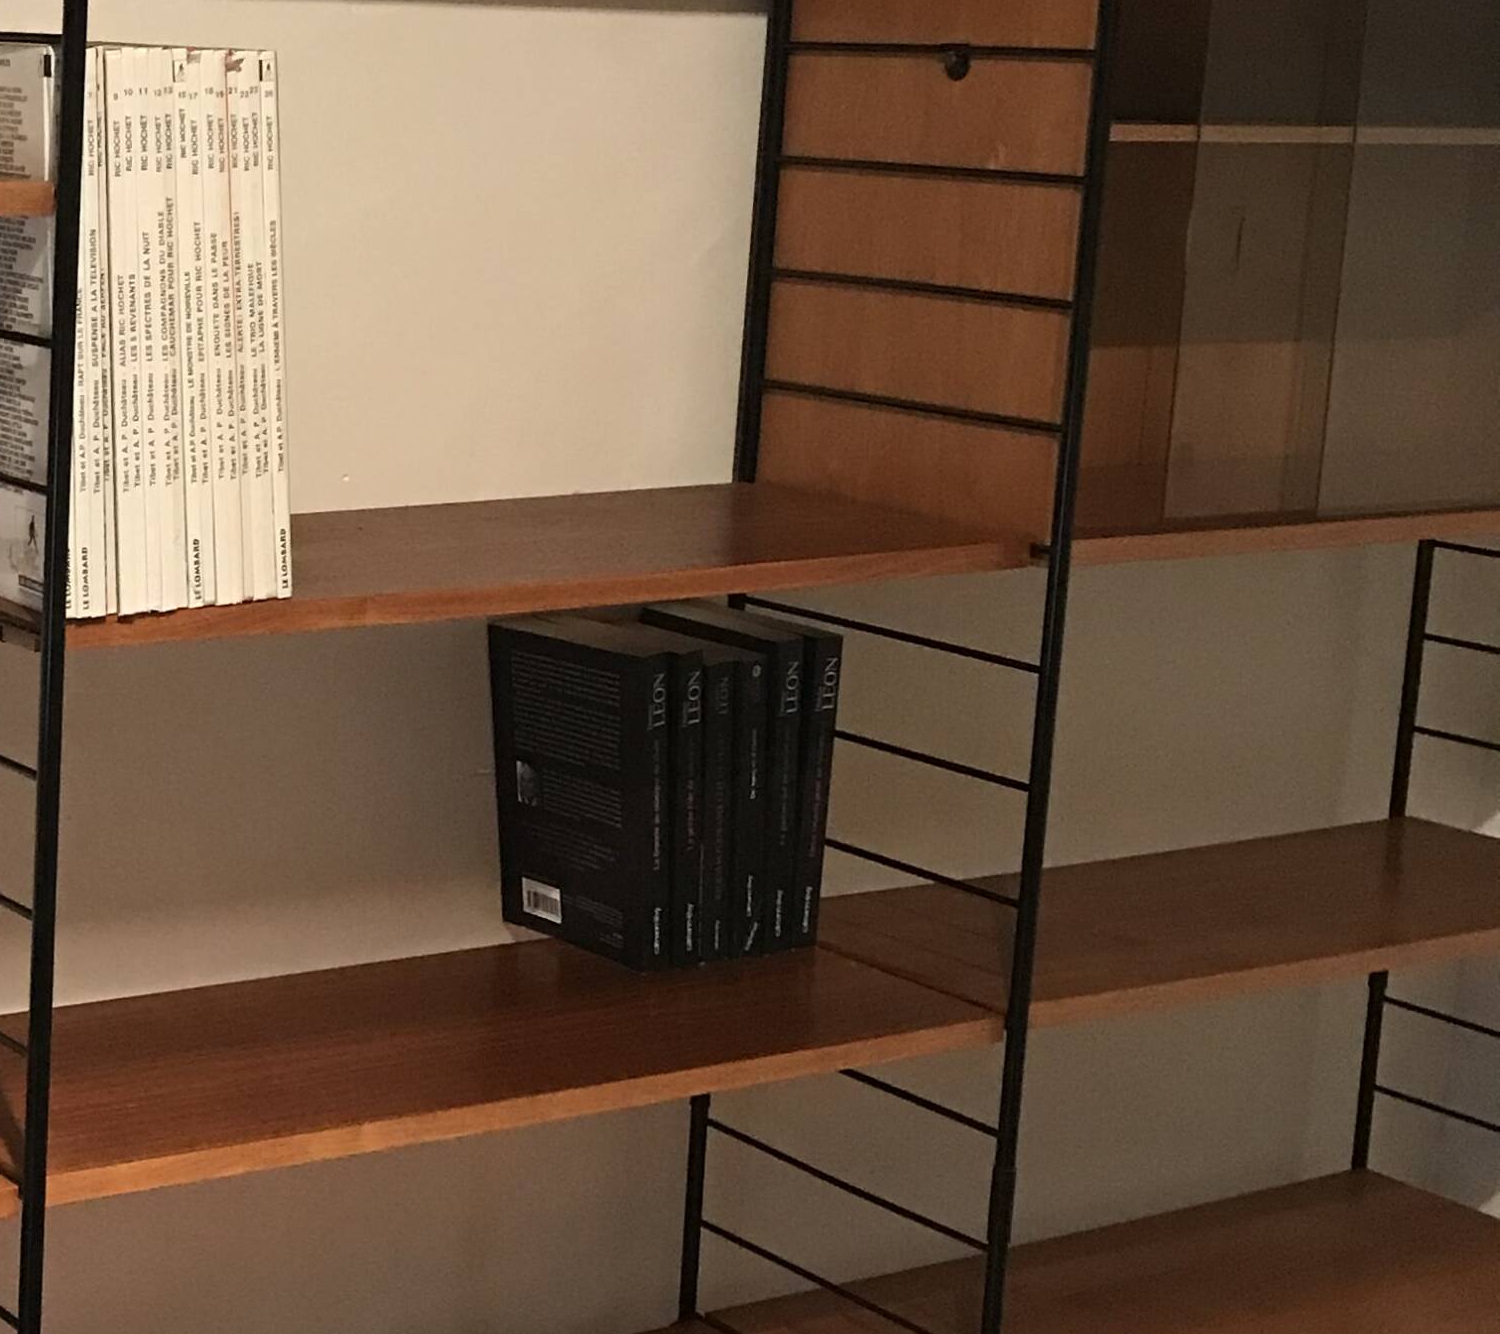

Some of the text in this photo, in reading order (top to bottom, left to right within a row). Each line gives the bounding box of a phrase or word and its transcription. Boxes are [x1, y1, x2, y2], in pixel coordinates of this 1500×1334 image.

[165, 197, 173, 237] HOCHET
[193, 222, 201, 261] HOCHET
[90, 290, 97, 301] LA
[117, 275, 125, 315] HOCHET
[142, 232, 153, 362] LES SPECTRES DE LA NUIT
[159, 269, 168, 341] COMPAGNONS
[195, 286, 203, 312] POUR
[223, 287, 230, 299] DE
[91, 316, 99, 367] SUSPENSE
[118, 319, 126, 335] RIC
[168, 294, 176, 356] CAUCHEMAR
[81, 547, 89, 610] LE LOMBARD
[193, 539, 201, 588] LOMBARD
[279, 529, 288, 589] LE LOMBARD
[652, 673, 666, 727] LEON
[684, 670, 702, 724] LEON
[785, 661, 800, 714] LEON
[820, 657, 838, 710] LEON
